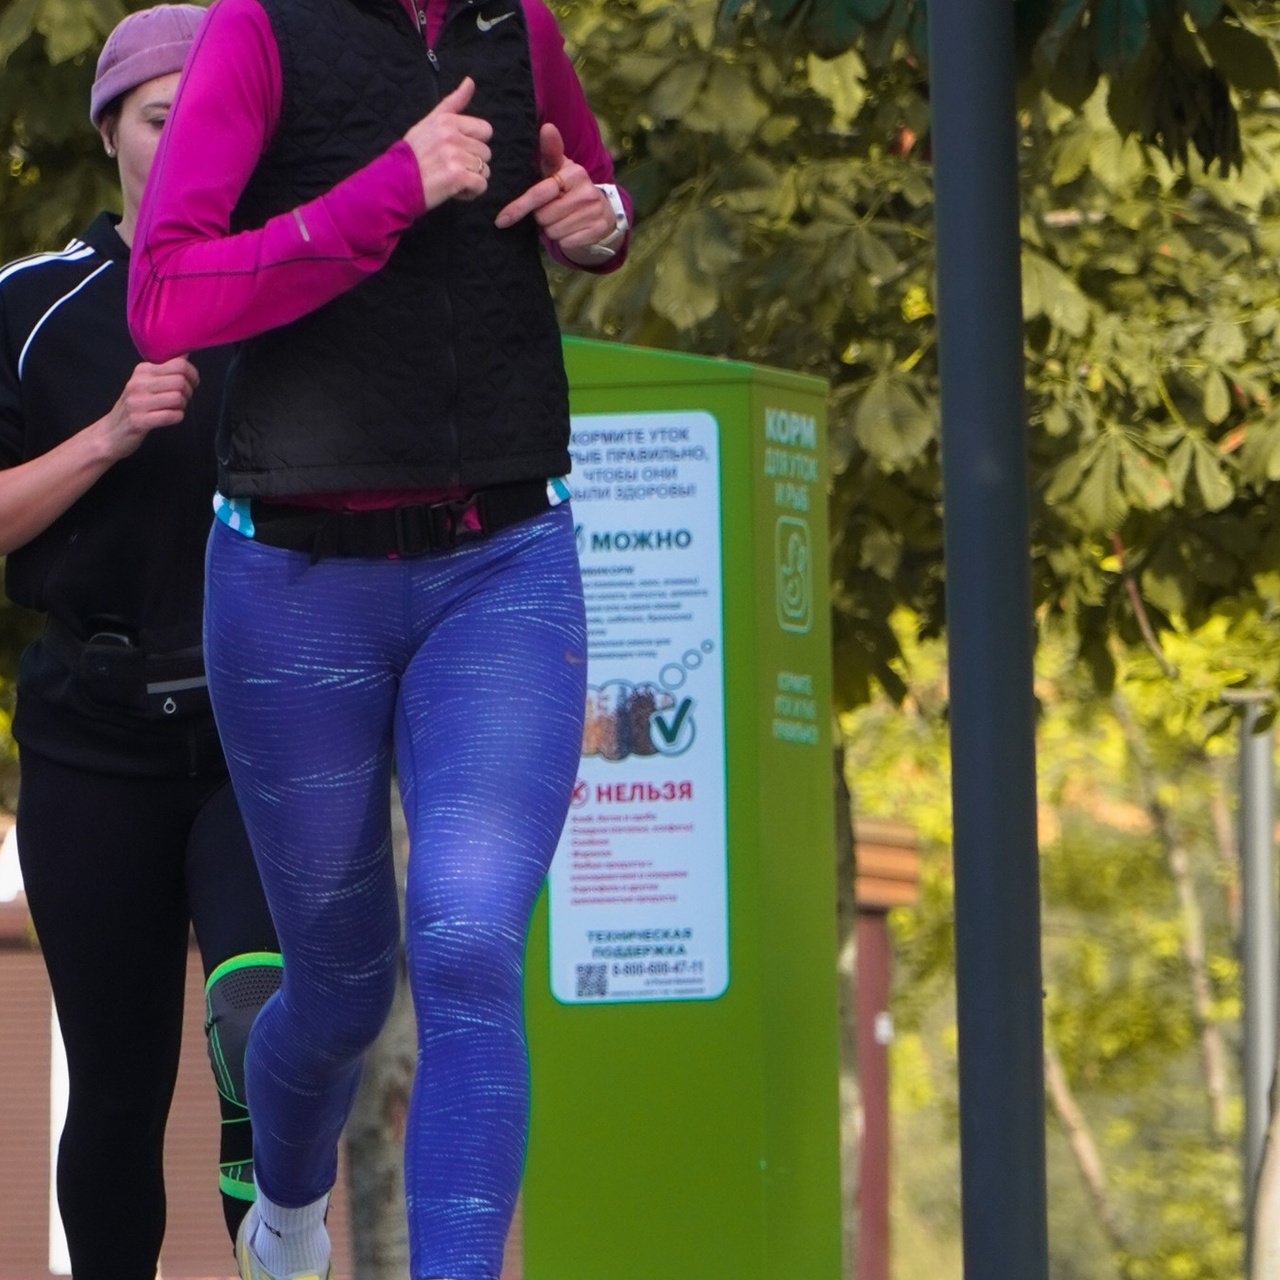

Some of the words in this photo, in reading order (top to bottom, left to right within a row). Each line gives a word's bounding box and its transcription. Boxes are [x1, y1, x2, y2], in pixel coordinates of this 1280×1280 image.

[571, 429, 646, 445] КОРМИТЕ
[648, 426, 690, 443] УТОК
[606, 445, 709, 463] ПРАВИЛЬНО,
[582, 467, 639, 483] ЧТОБЫ
[642, 465, 679, 482] ОНИ
[615, 483, 697, 501] ЗДОРОВЫ!
[591, 528, 693, 552] МОЖНО
[596, 779, 693, 804] НЕЛЬЗЯ
[587, 927, 693, 943] ТЕХНИЧЕСКАЯ
[592, 944, 687, 959] ПОДДЕРЖКА
